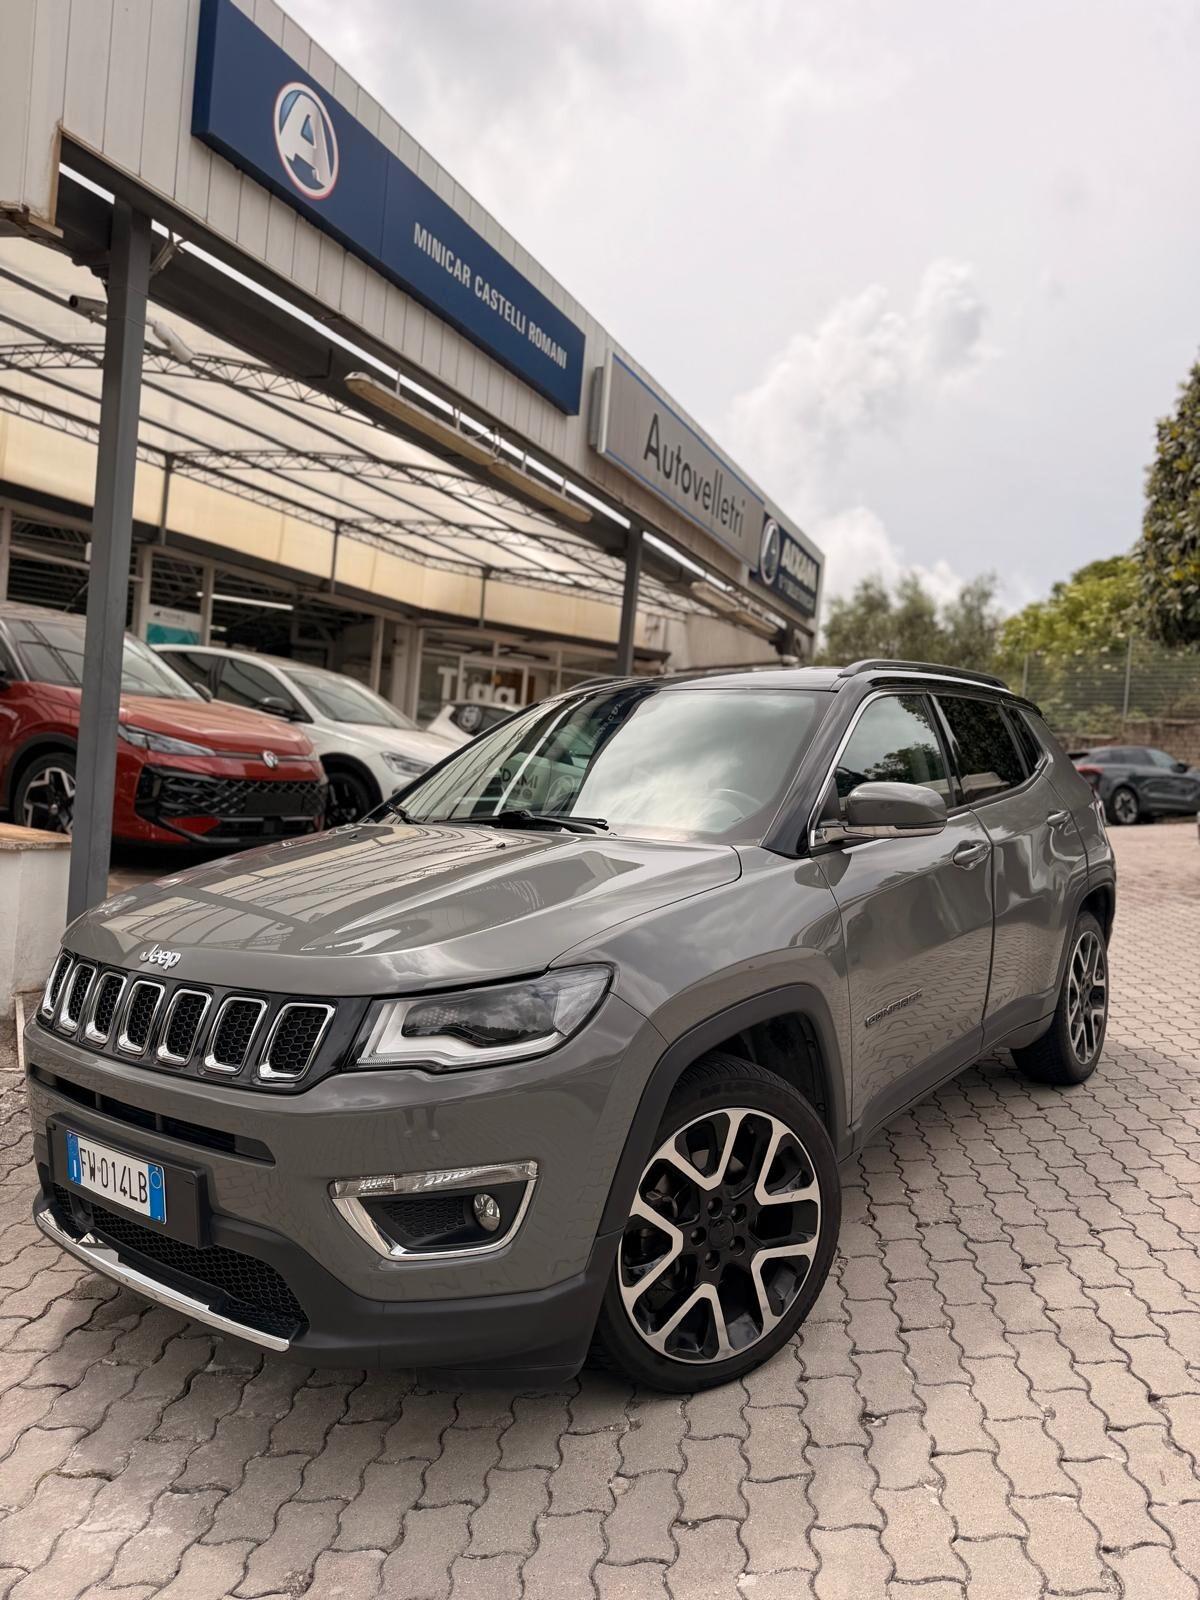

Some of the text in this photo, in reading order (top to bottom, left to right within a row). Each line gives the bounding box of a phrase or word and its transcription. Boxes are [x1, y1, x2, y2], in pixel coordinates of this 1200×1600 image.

[413, 222, 567, 369] MINICAR CASTELLI ROMANI
[644, 413, 744, 537] Autovelletri
[139, 943, 181, 970] Jeep
